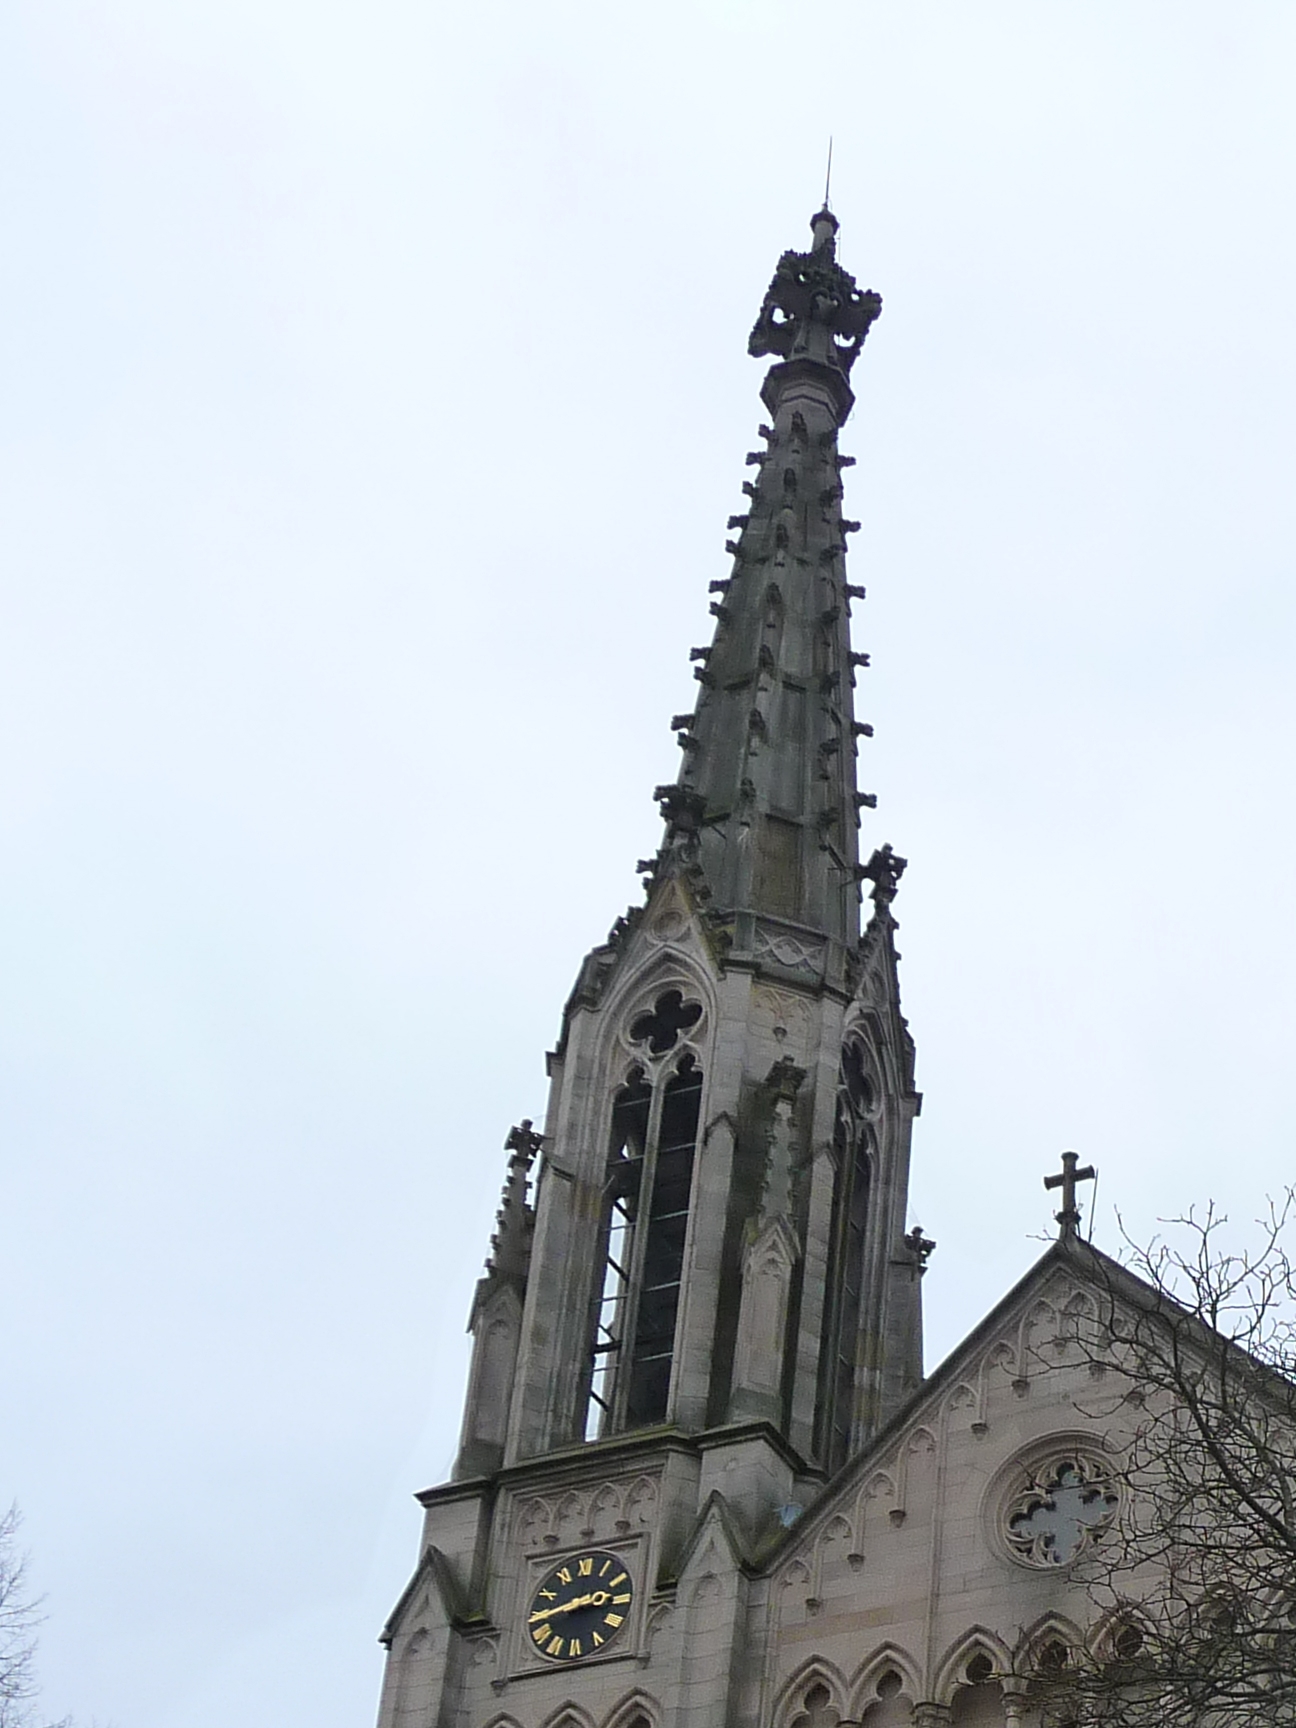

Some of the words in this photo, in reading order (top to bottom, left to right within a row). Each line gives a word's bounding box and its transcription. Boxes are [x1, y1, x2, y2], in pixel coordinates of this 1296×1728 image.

[556, 1567, 573, 1585] XI
[577, 1557, 593, 1577] XII
[538, 1588, 557, 1601] X
